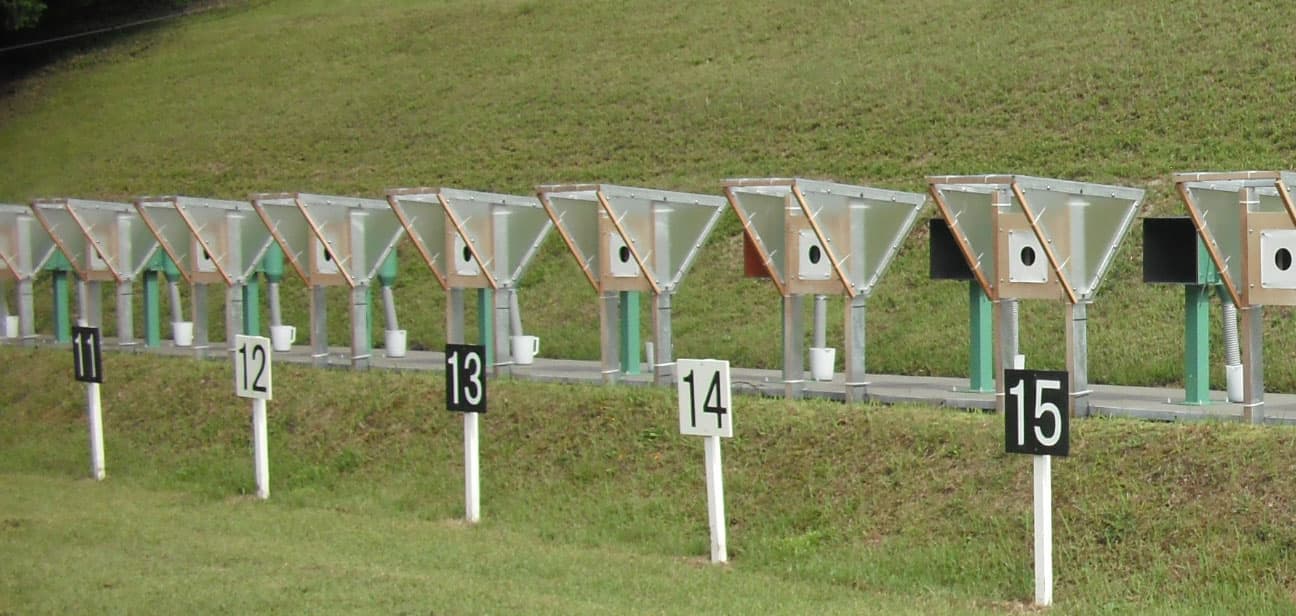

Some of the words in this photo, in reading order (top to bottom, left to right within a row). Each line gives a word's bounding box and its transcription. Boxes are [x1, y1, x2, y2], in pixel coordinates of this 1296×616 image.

[74, 333, 98, 378] 11
[238, 343, 268, 393] 12
[447, 351, 483, 406] 13
[682, 370, 728, 429] 14
[1009, 379, 1062, 447] 15
